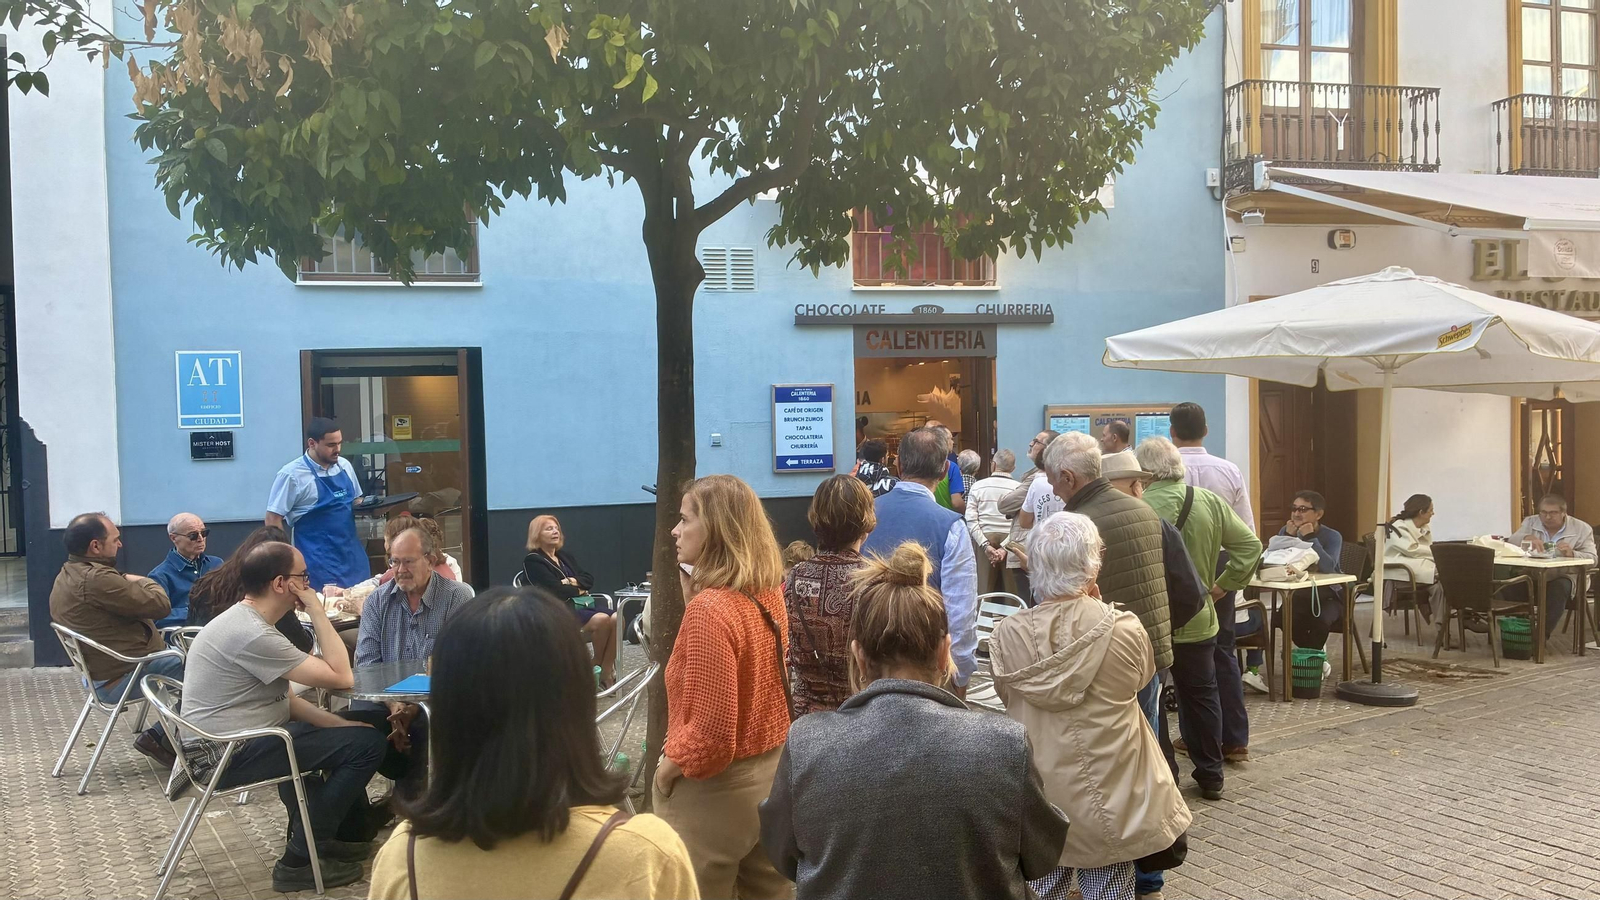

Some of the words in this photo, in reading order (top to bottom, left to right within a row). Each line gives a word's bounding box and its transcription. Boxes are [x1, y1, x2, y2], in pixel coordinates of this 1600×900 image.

[1312, 260, 1318, 272] 9
[1471, 239, 1530, 282] EL
[794, 304, 886, 316] CHOCOLATE
[975, 304, 1053, 316] CHURRERIA
[866, 330, 986, 350] CALENTERIA
[1438, 326, 1472, 346] Schweppes
[187, 358, 232, 386] AT
